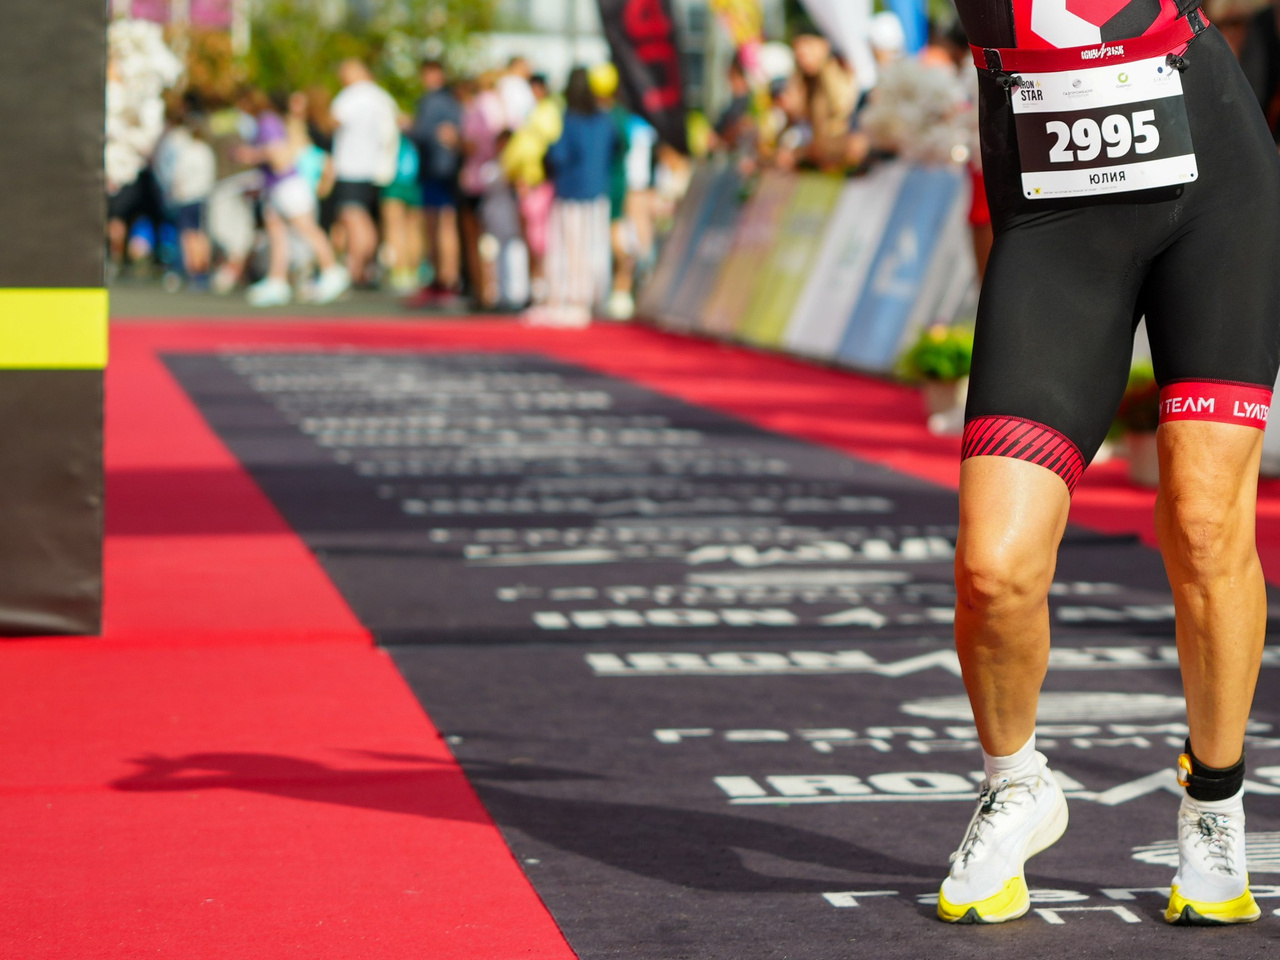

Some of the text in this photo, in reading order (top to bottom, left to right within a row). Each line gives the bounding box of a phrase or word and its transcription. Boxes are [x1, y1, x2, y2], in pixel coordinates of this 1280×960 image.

[1020, 89, 1044, 102] STAR
[1046, 109, 1160, 163] 2995
[1089, 171, 1126, 185] ЮЛИЯ
[1166, 396, 1215, 414] TEAM
